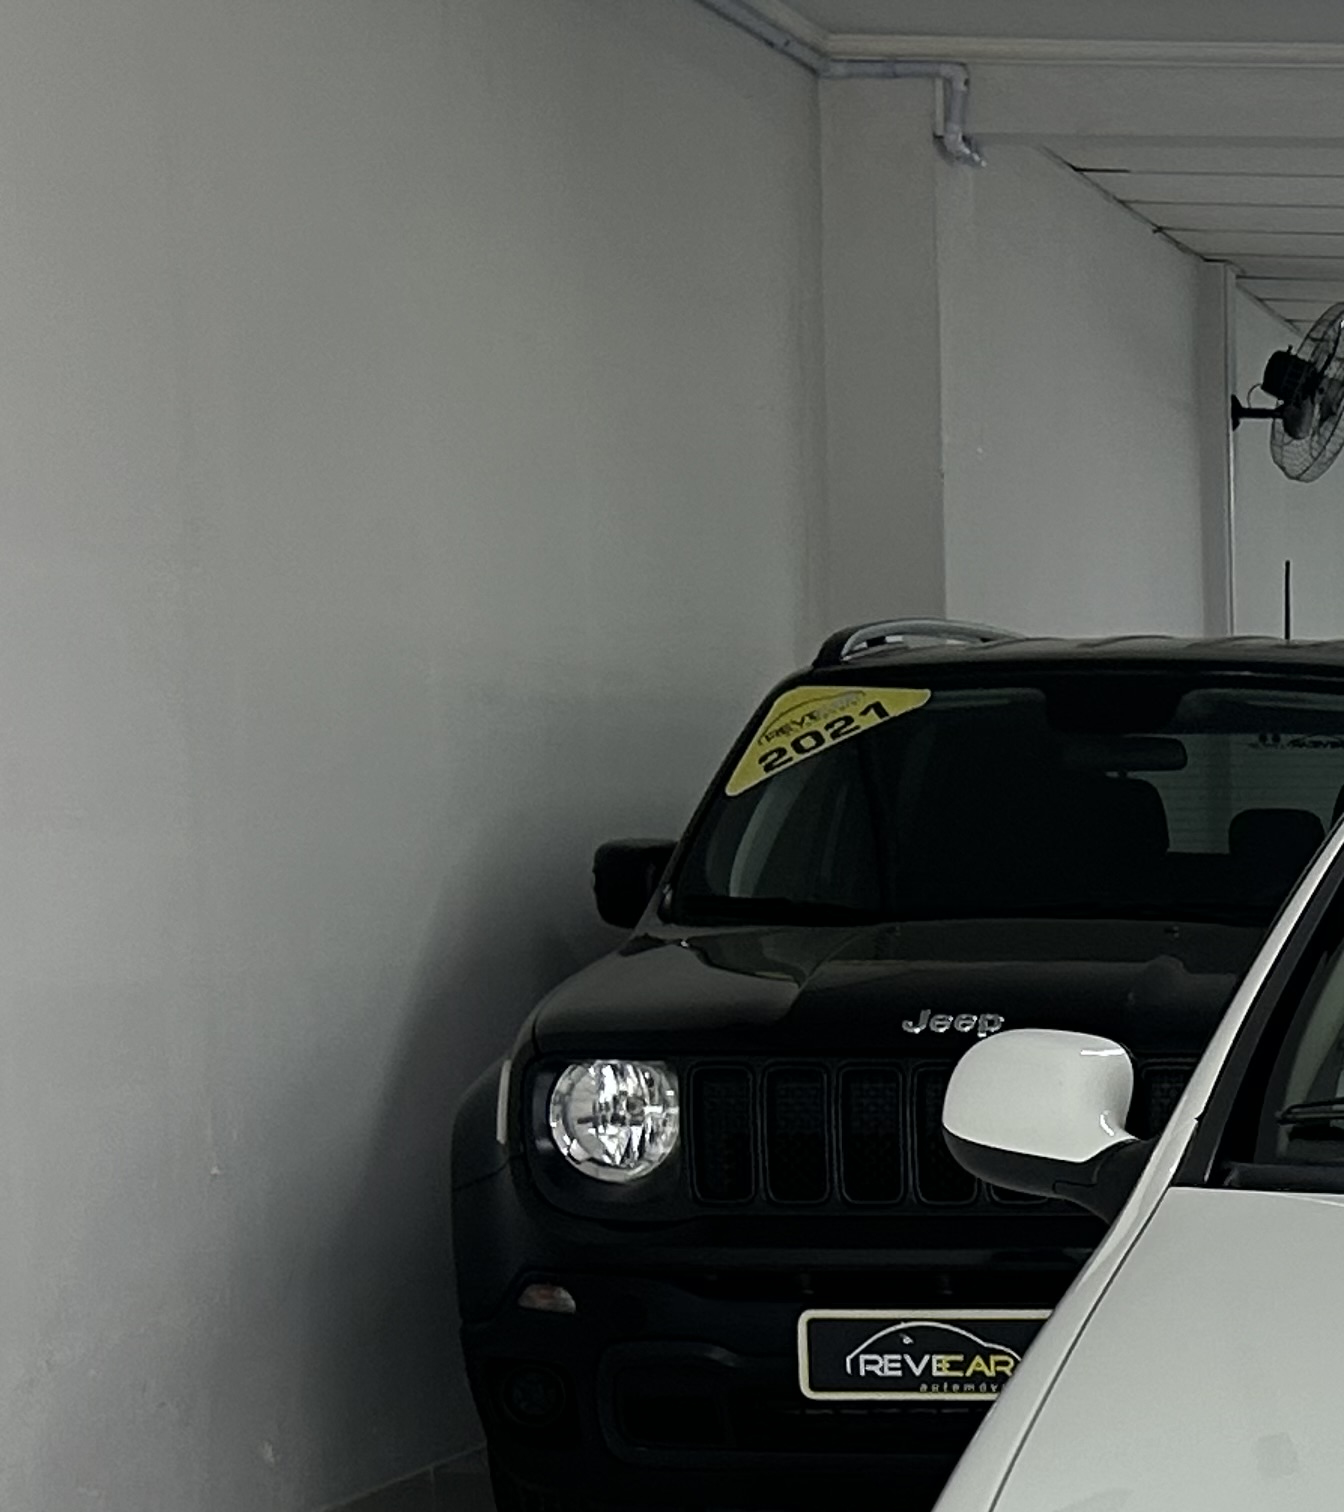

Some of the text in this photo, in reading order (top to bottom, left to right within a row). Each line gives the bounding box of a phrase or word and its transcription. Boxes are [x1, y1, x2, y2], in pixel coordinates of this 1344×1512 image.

[758, 701, 890, 773] 2021
[901, 1009, 1005, 1038] Jeep
[858, 1354, 1015, 1377] REVECAR
[919, 1381, 1008, 1393] automóv
